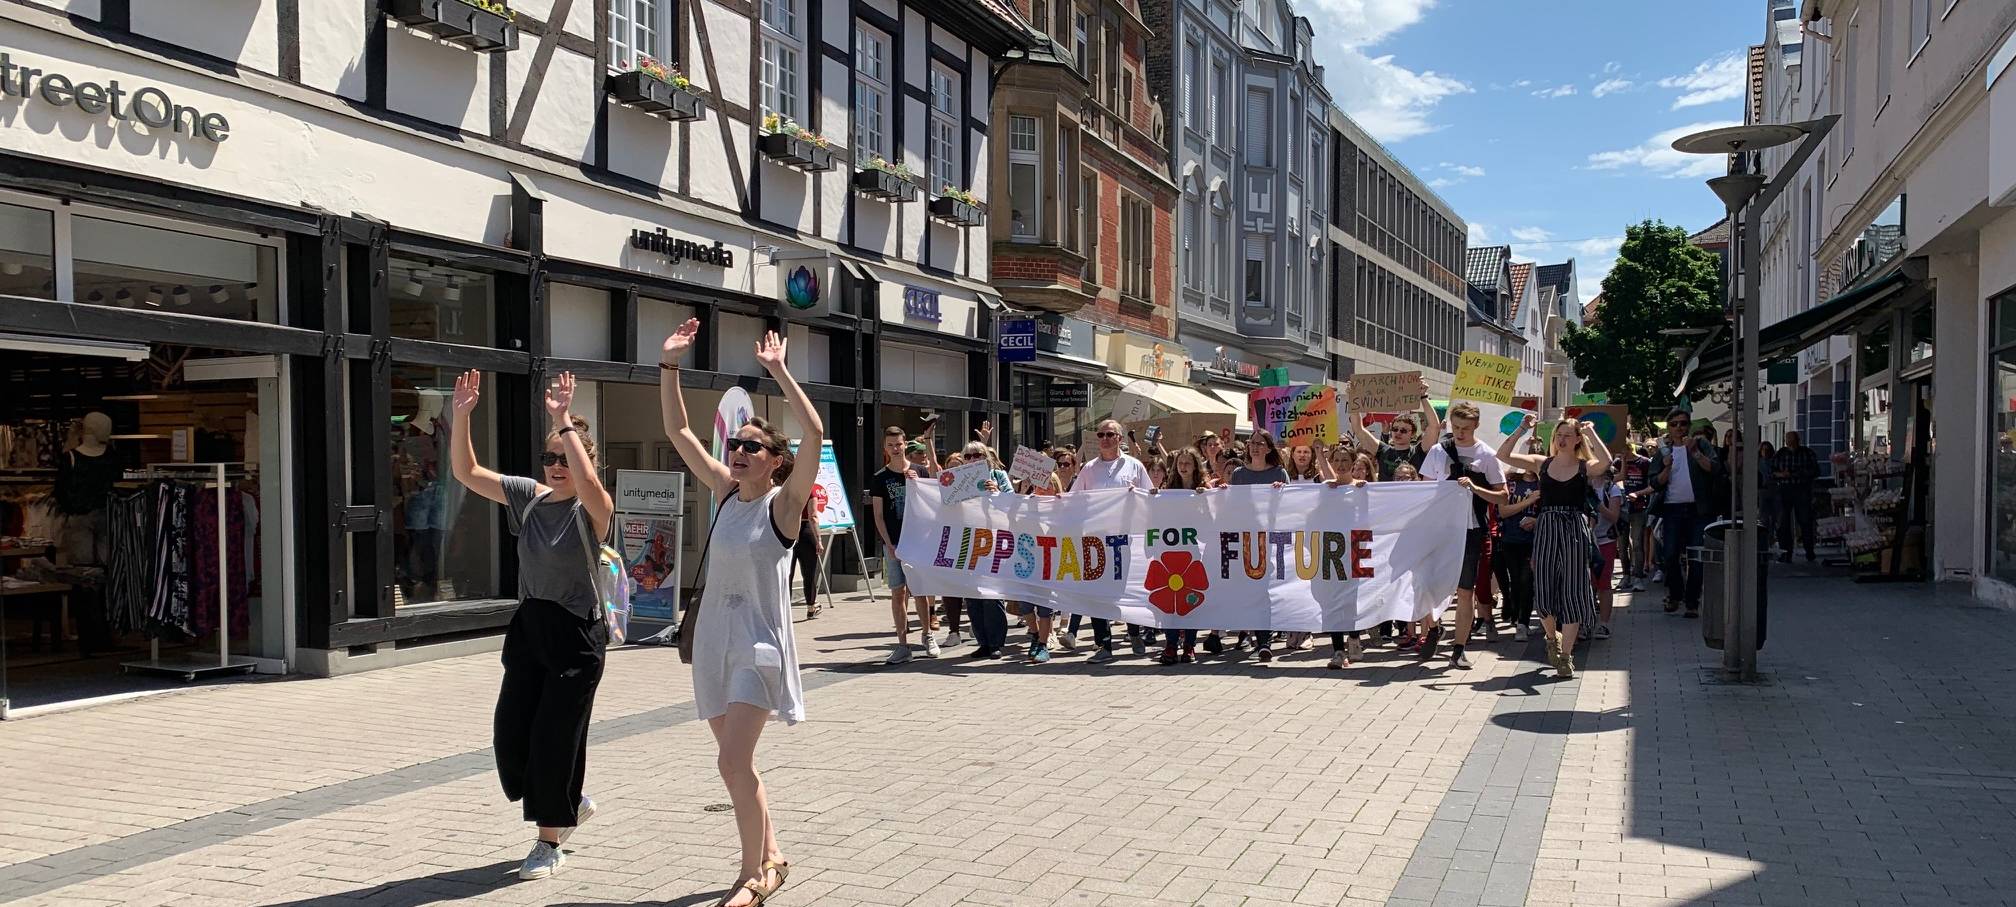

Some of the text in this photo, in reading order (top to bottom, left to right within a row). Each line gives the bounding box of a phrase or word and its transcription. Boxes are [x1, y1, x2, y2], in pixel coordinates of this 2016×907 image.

[630, 227, 734, 268] unitymedia
[1001, 336, 1034, 347] CECIL
[1465, 355, 1514, 376] WENN DIE
[1354, 376, 1397, 387] MARCH
[1296, 391, 1323, 401] nicht
[1351, 396, 1383, 410] SWIM
[1299, 409, 1327, 417] wann
[624, 487, 675, 500] unitymedia
[624, 524, 649, 534] MEHR
[934, 526, 1375, 581] LIPPSTADT FOR FUTURE
